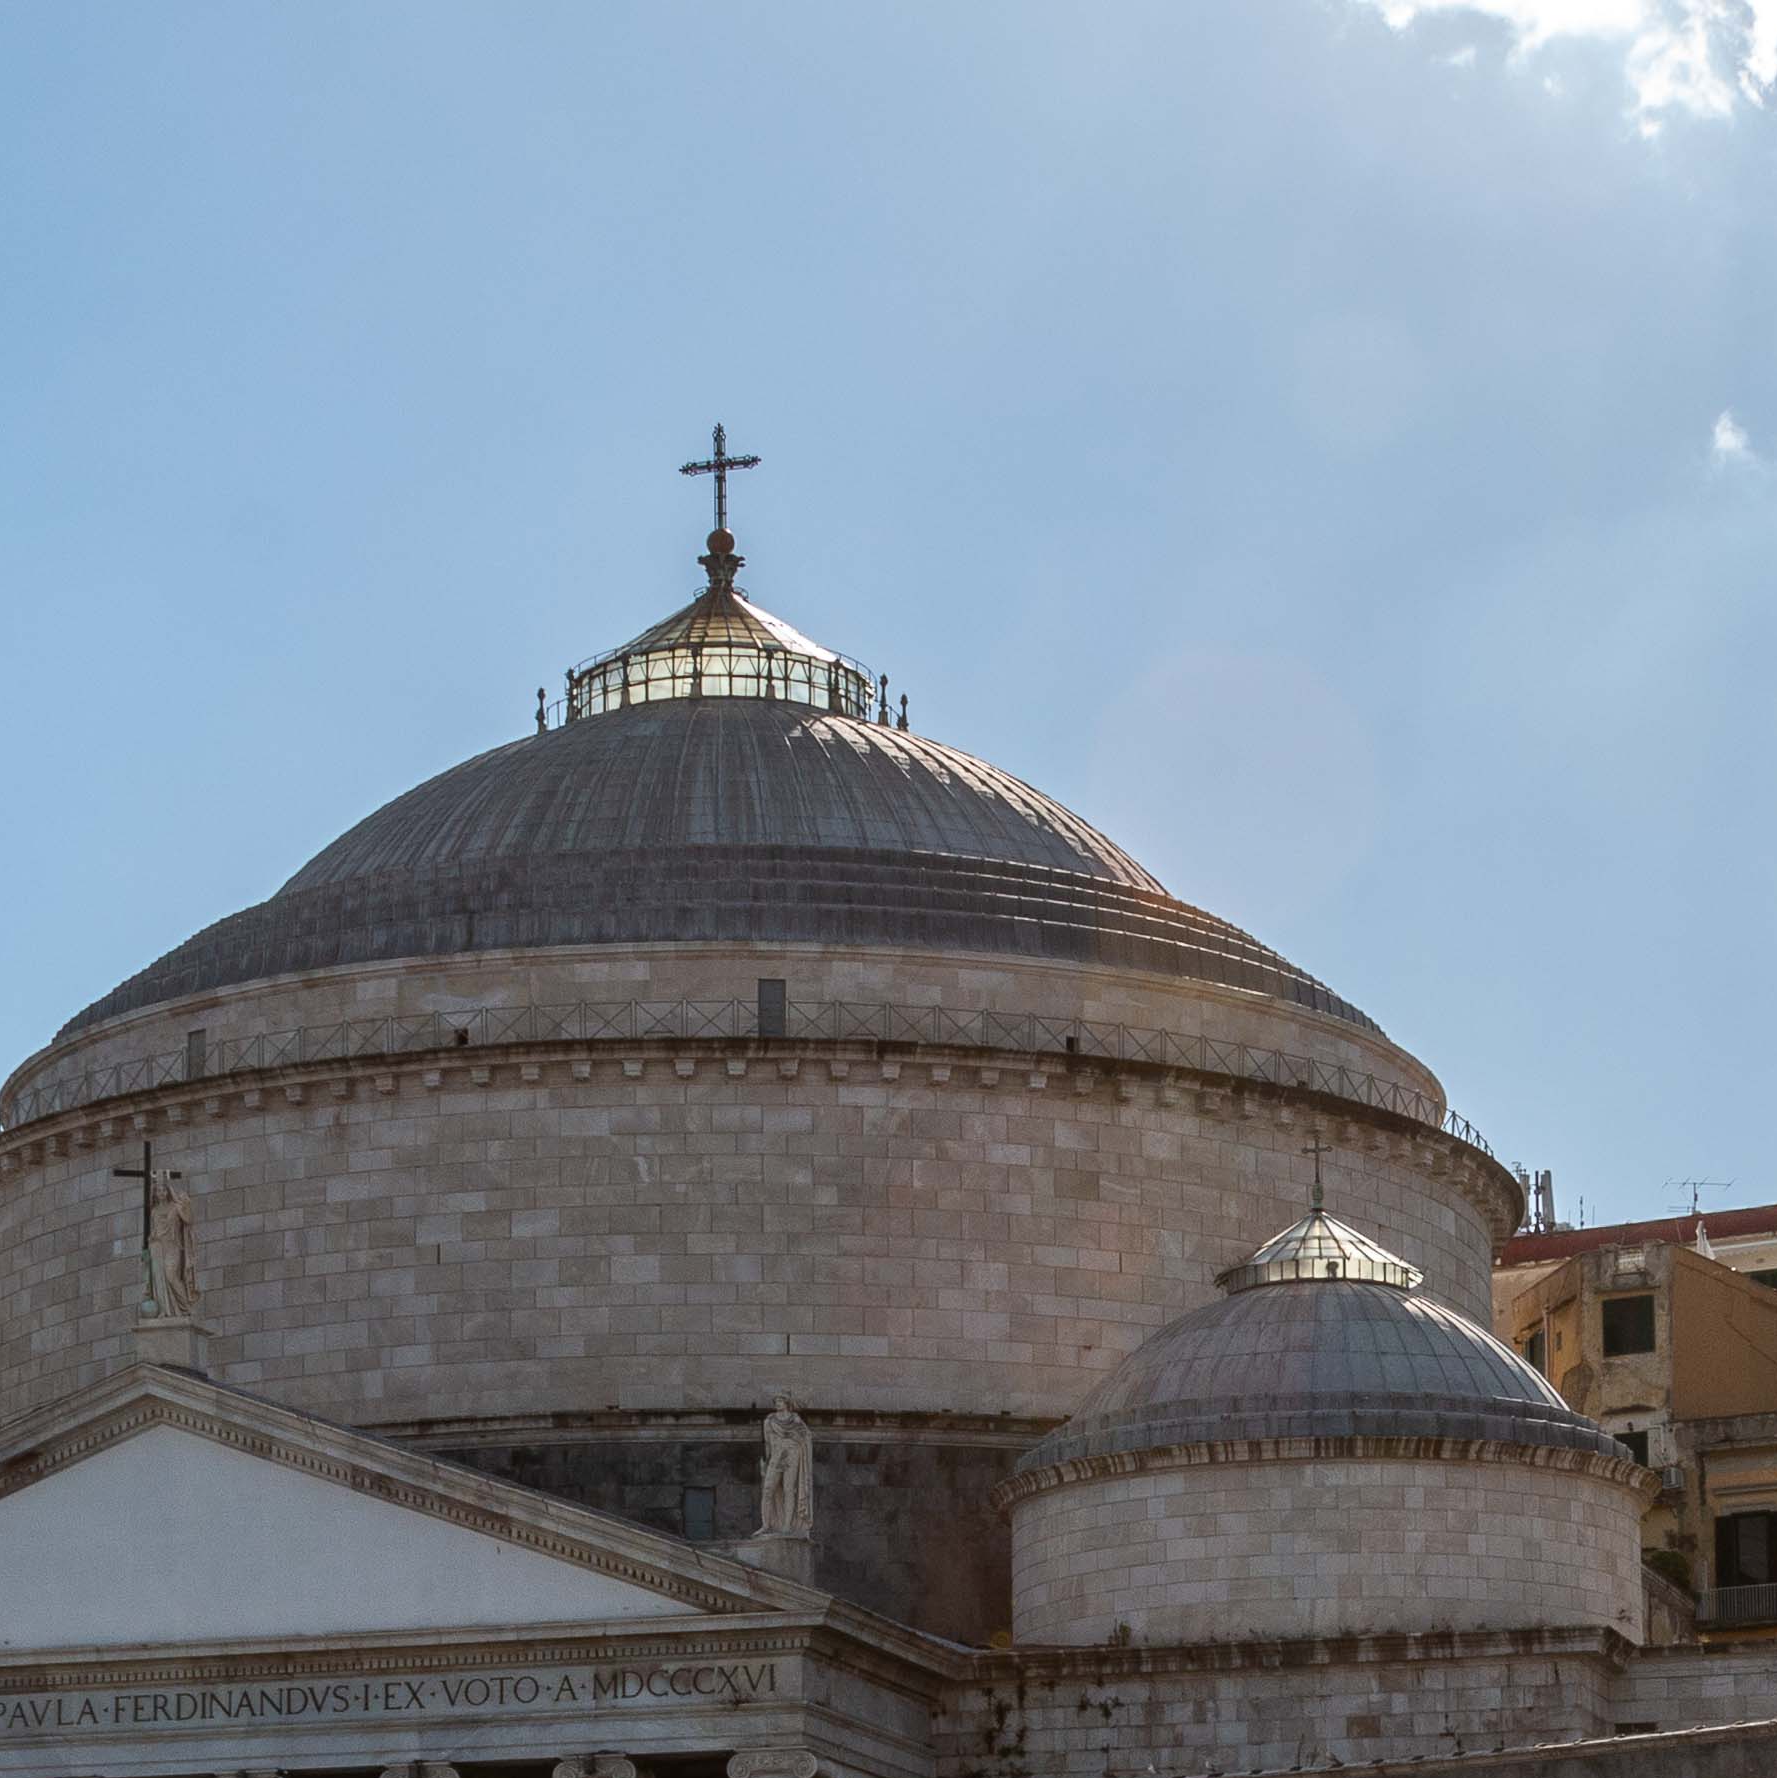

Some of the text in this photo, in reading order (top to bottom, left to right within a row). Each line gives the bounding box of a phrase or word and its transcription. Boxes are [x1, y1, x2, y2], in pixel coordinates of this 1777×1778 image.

[112, 1685, 350, 1724] FERDINANDVS
[383, 1680, 425, 1711] EX
[440, 1676, 540, 1708] VOTO
[554, 1674, 578, 1703] A
[592, 1664, 776, 1702] MDCCCXVI
